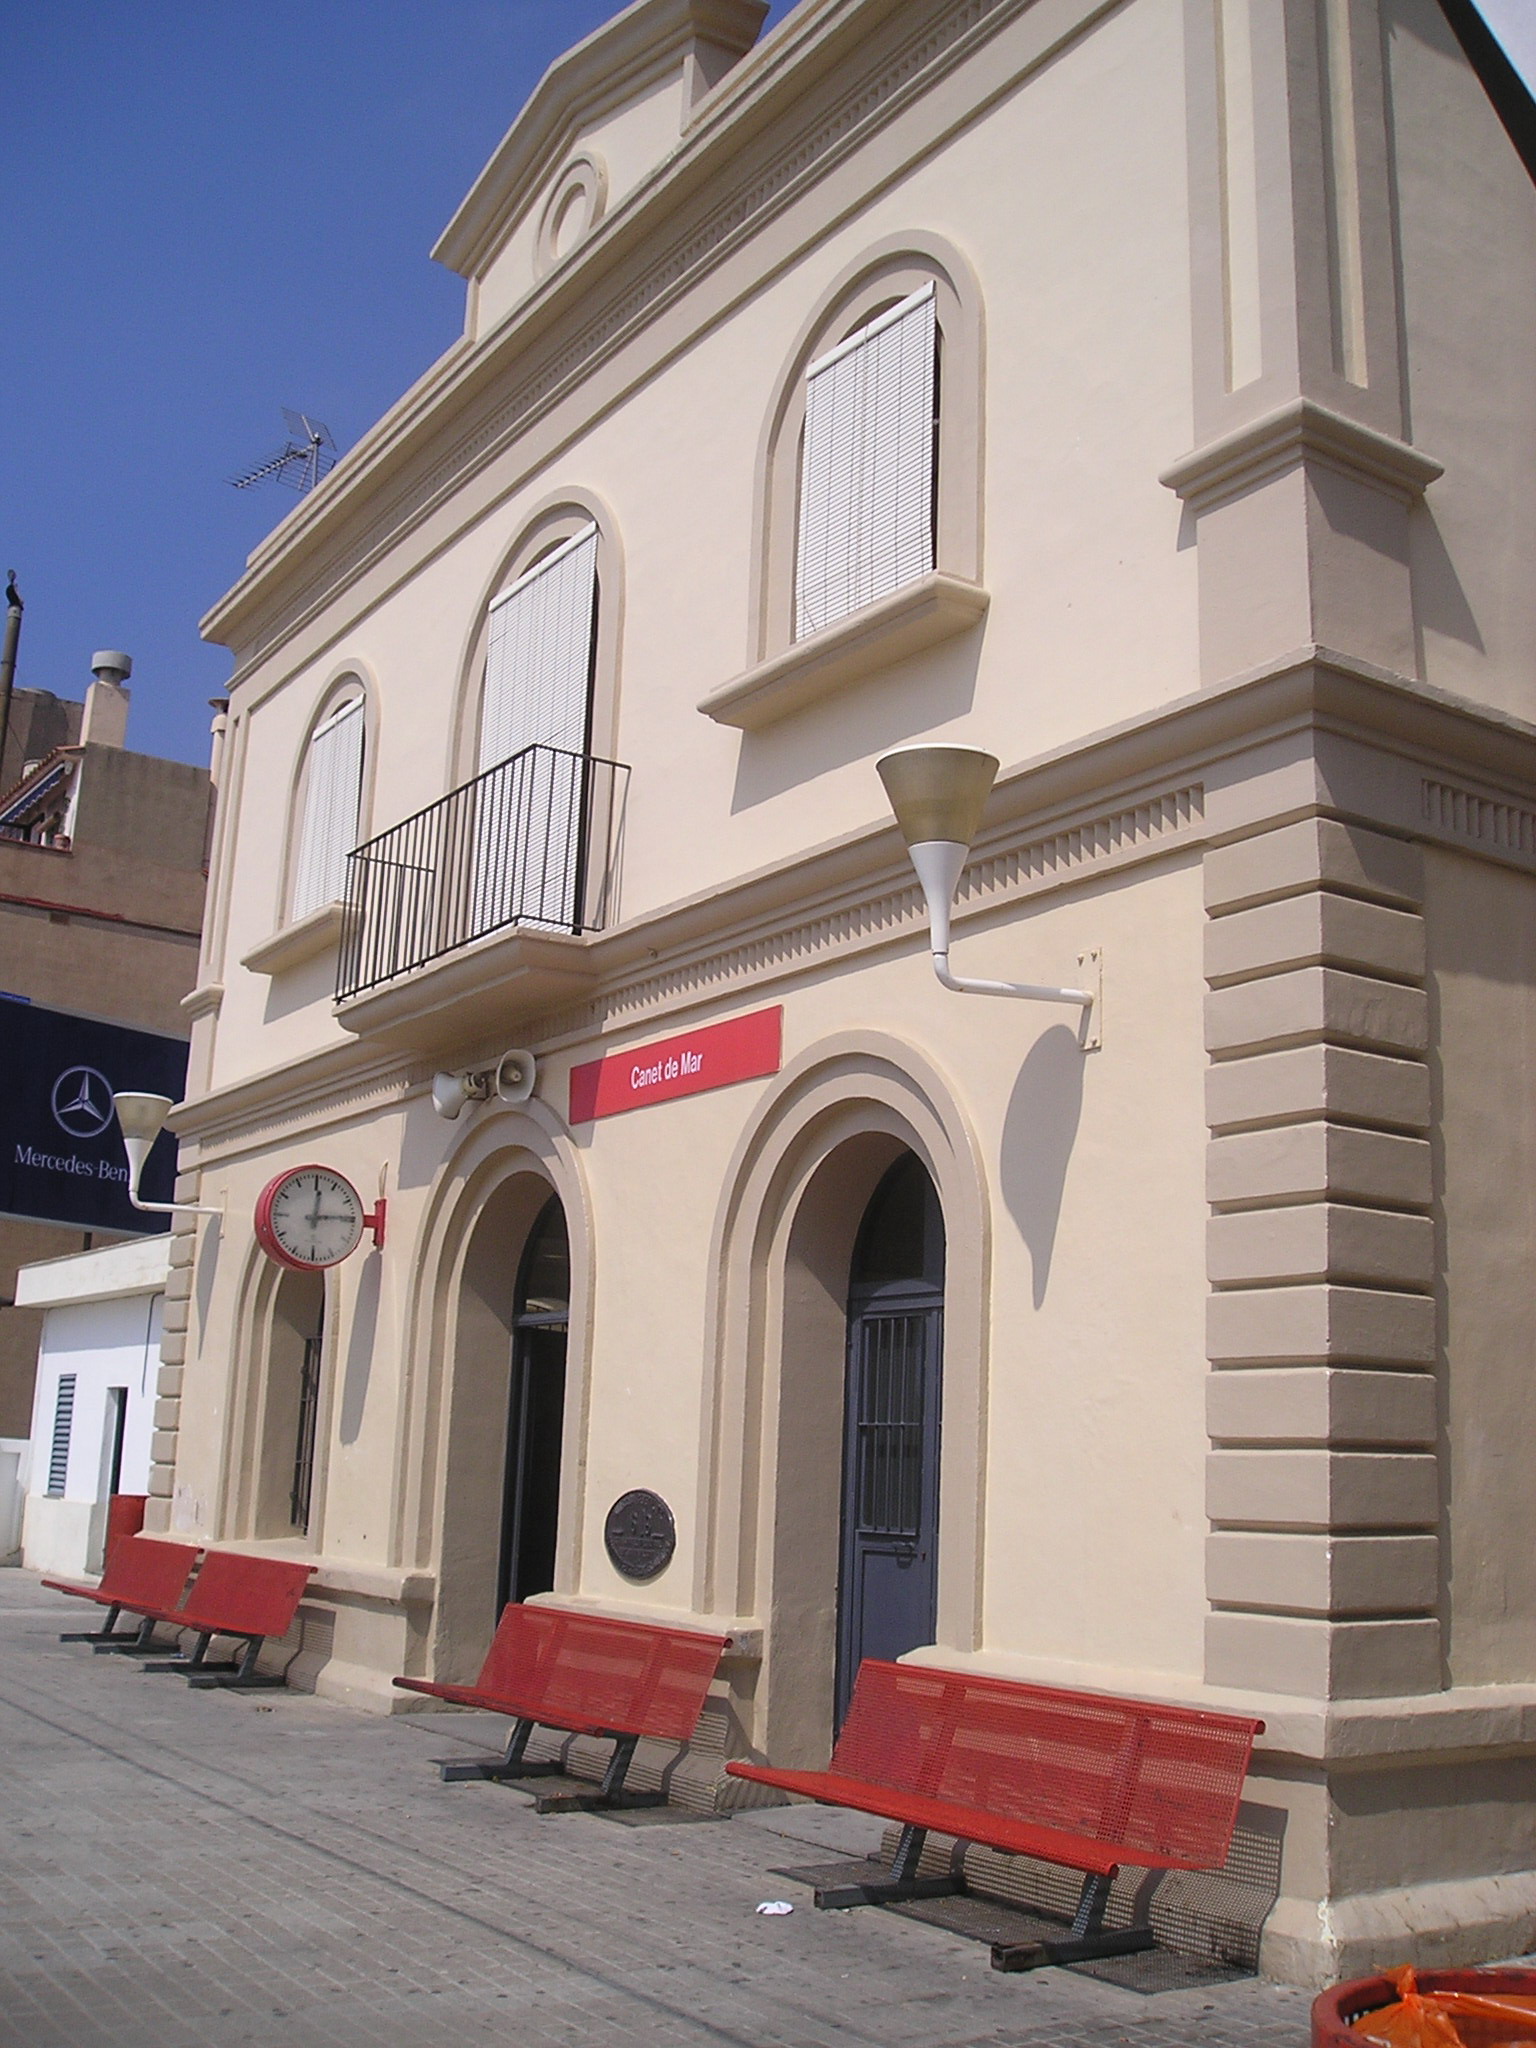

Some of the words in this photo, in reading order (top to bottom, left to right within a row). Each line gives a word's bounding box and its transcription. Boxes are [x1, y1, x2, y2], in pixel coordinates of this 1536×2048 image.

[631, 1061, 662, 1089] Canet
[664, 1056, 679, 1079] de
[681, 1051, 703, 1075] Mar
[14, 1144, 129, 1182] Mercedes-Ben
